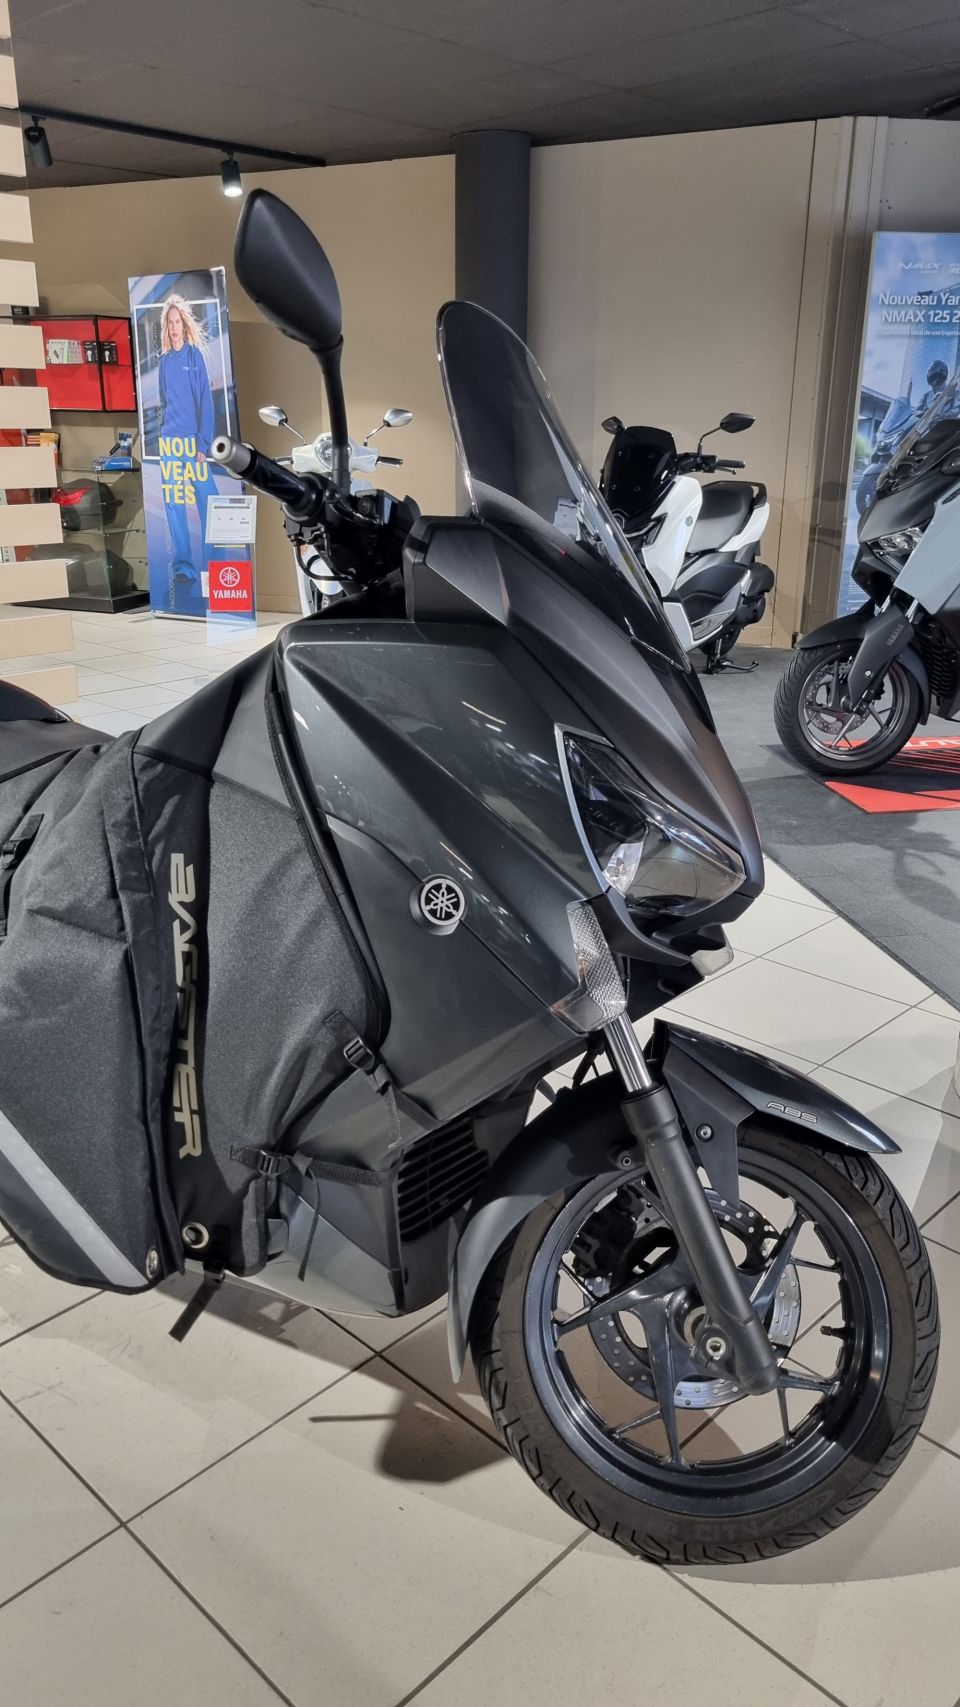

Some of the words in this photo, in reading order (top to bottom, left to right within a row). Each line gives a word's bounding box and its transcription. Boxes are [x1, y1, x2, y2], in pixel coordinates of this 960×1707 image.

[879, 292, 938, 305] Nouveau
[882, 310, 926, 322] NMAX
[928, 310, 950, 322] 125
[158, 437, 197, 458] NOU
[160, 461, 209, 482] VEAU
[161, 480, 197, 505] TÉS
[213, 589, 248, 599] YAMAHA
[168, 853, 203, 1159] BAGSTER
[767, 1101, 817, 1124] ABS
